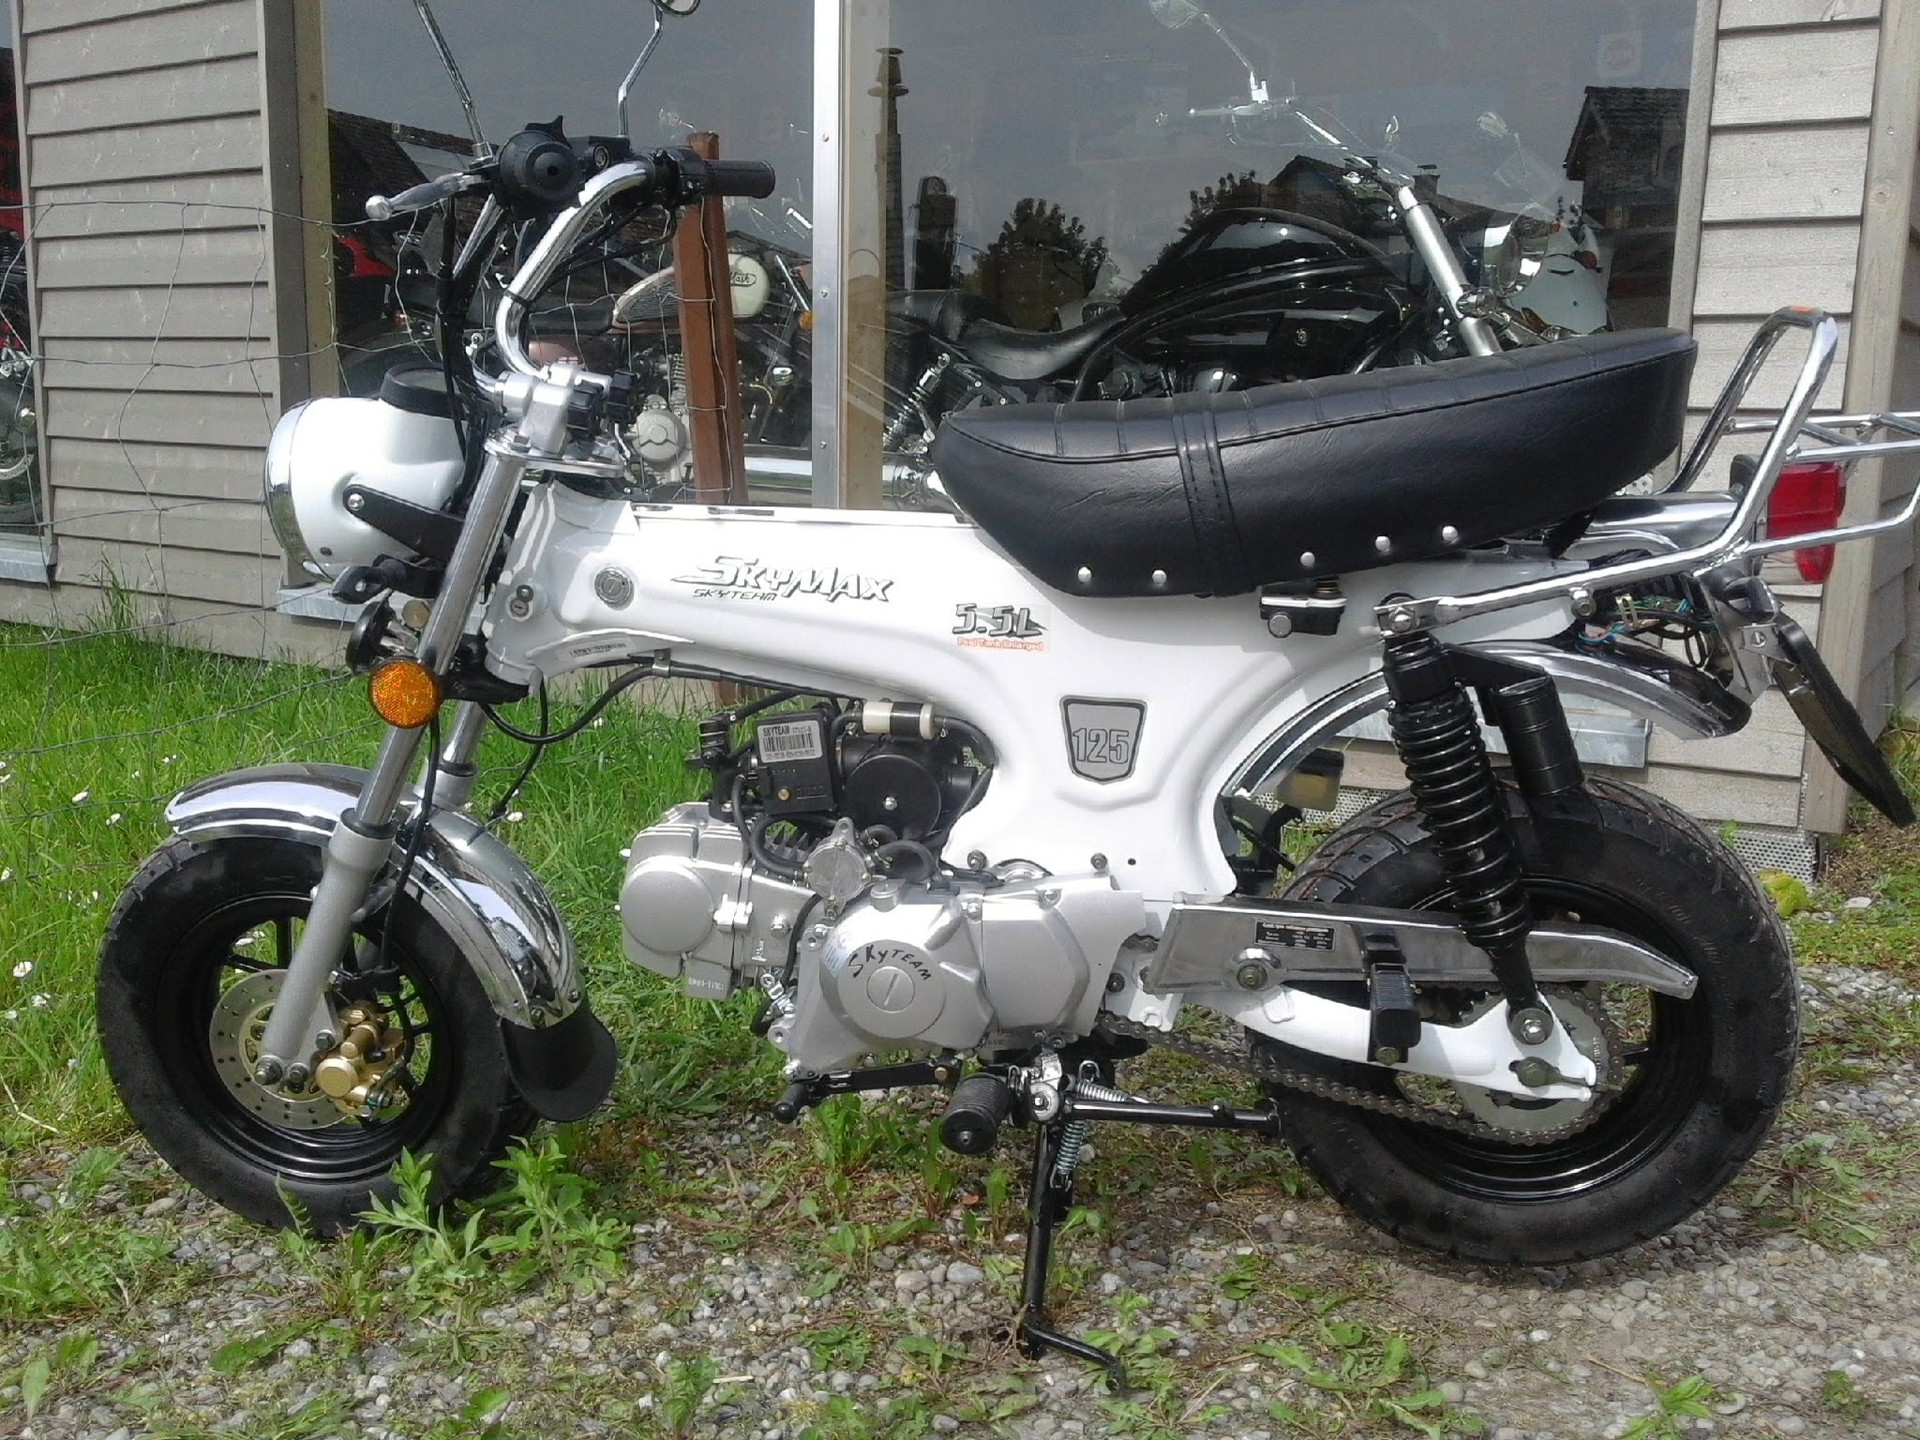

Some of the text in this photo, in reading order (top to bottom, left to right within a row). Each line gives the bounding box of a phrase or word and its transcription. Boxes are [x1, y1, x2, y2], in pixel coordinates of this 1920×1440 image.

[692, 588, 778, 602] SKYTEAM
[952, 603, 1043, 638] 5.5L
[1002, 639, 1045, 652] Enlarged
[1072, 727, 1130, 764] 125
